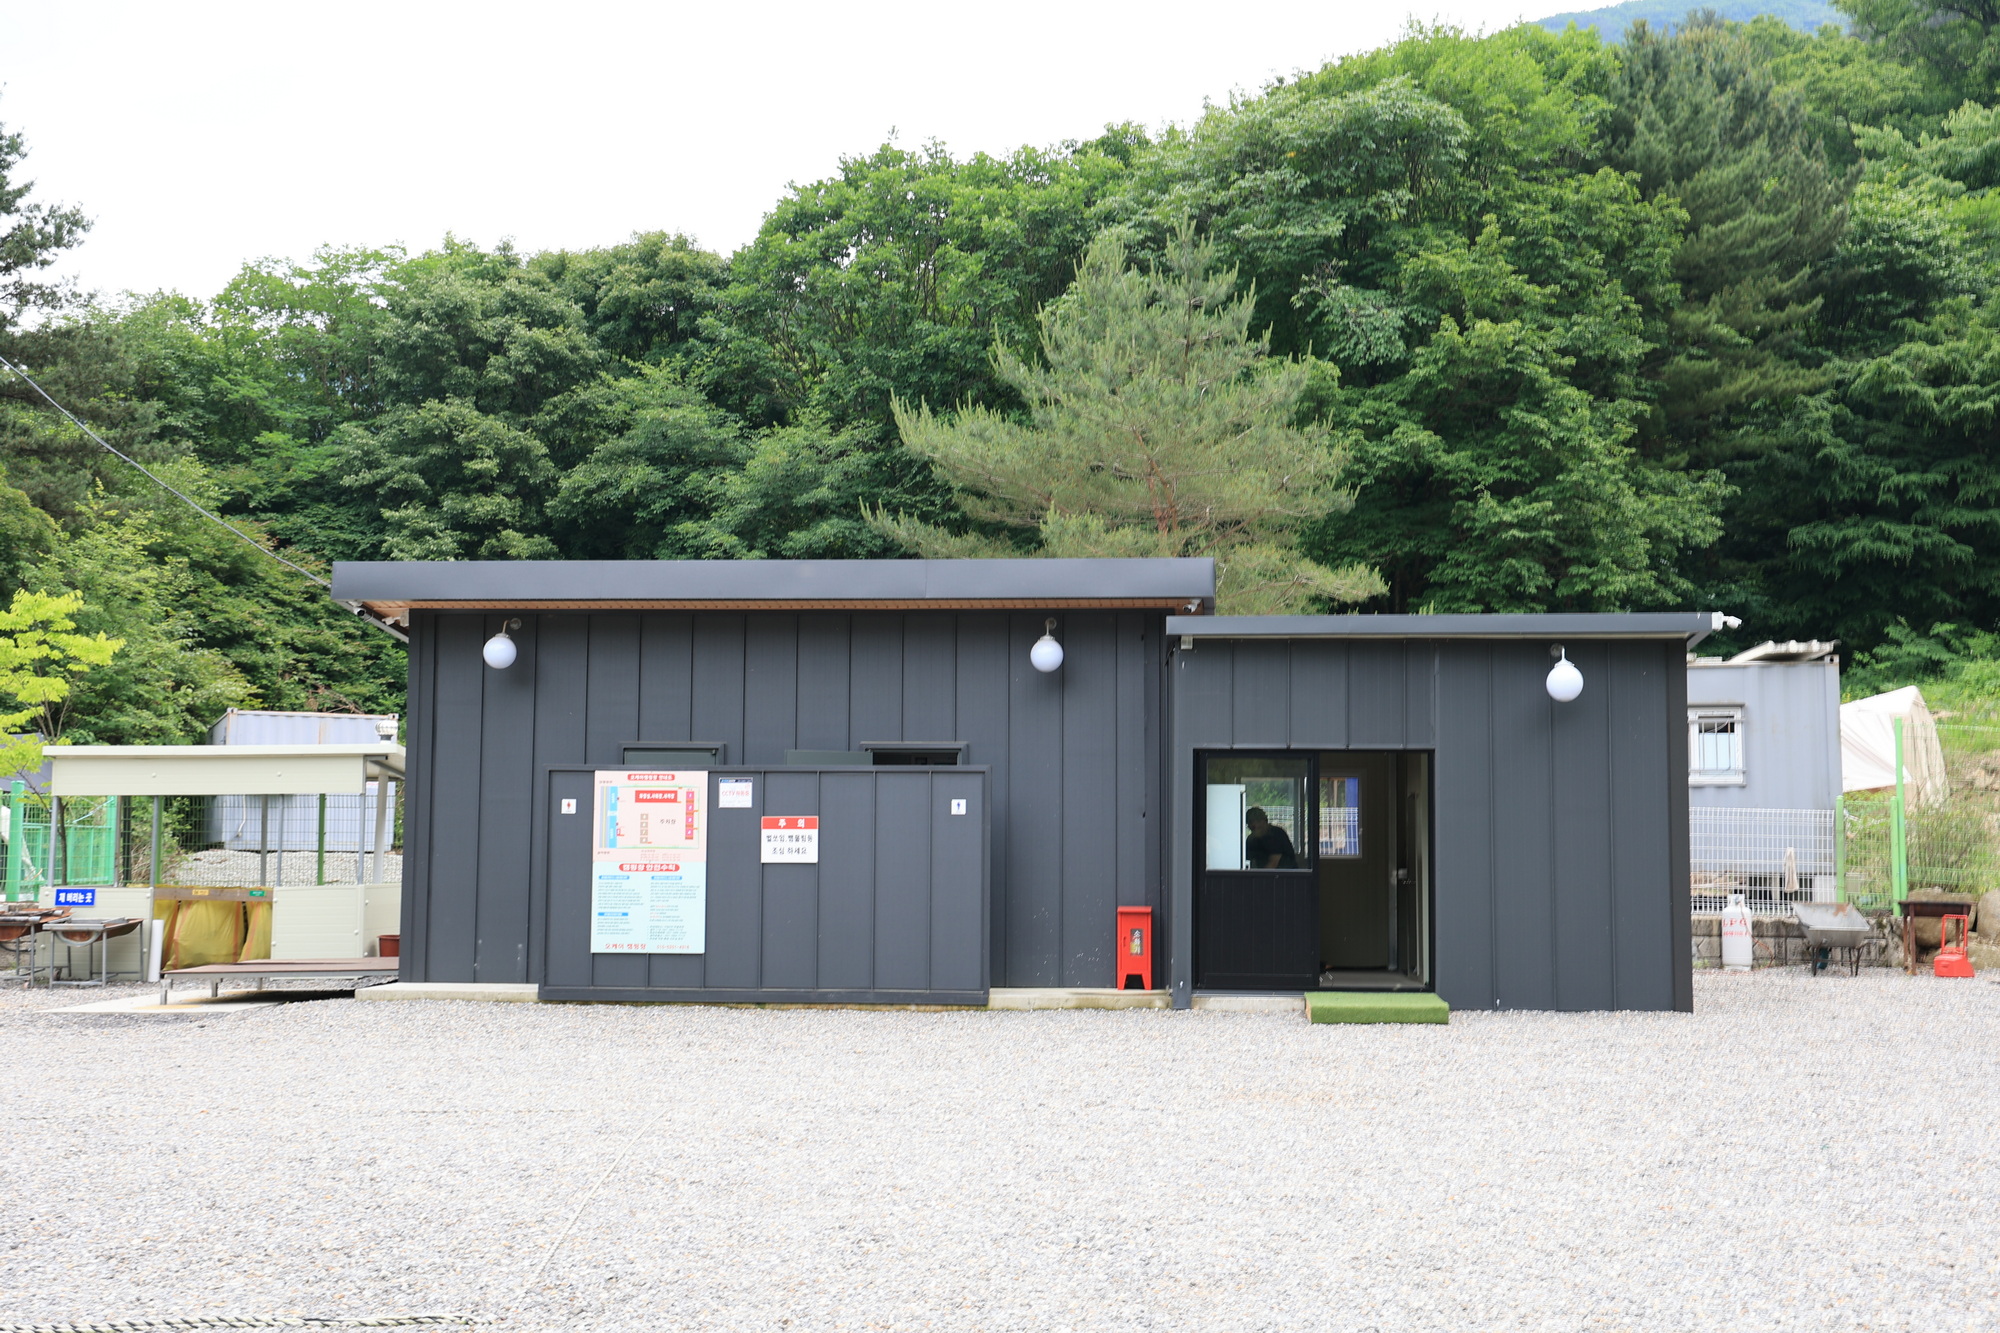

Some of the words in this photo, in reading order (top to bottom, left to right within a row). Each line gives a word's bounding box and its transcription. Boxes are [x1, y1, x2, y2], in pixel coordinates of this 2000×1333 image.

[772, 846, 785, 855] 조심
[787, 846, 808, 855] 하세요
[58, 892, 66, 903] 재
[66, 892, 85, 903] 버리는
[85, 892, 93, 903] 곳
